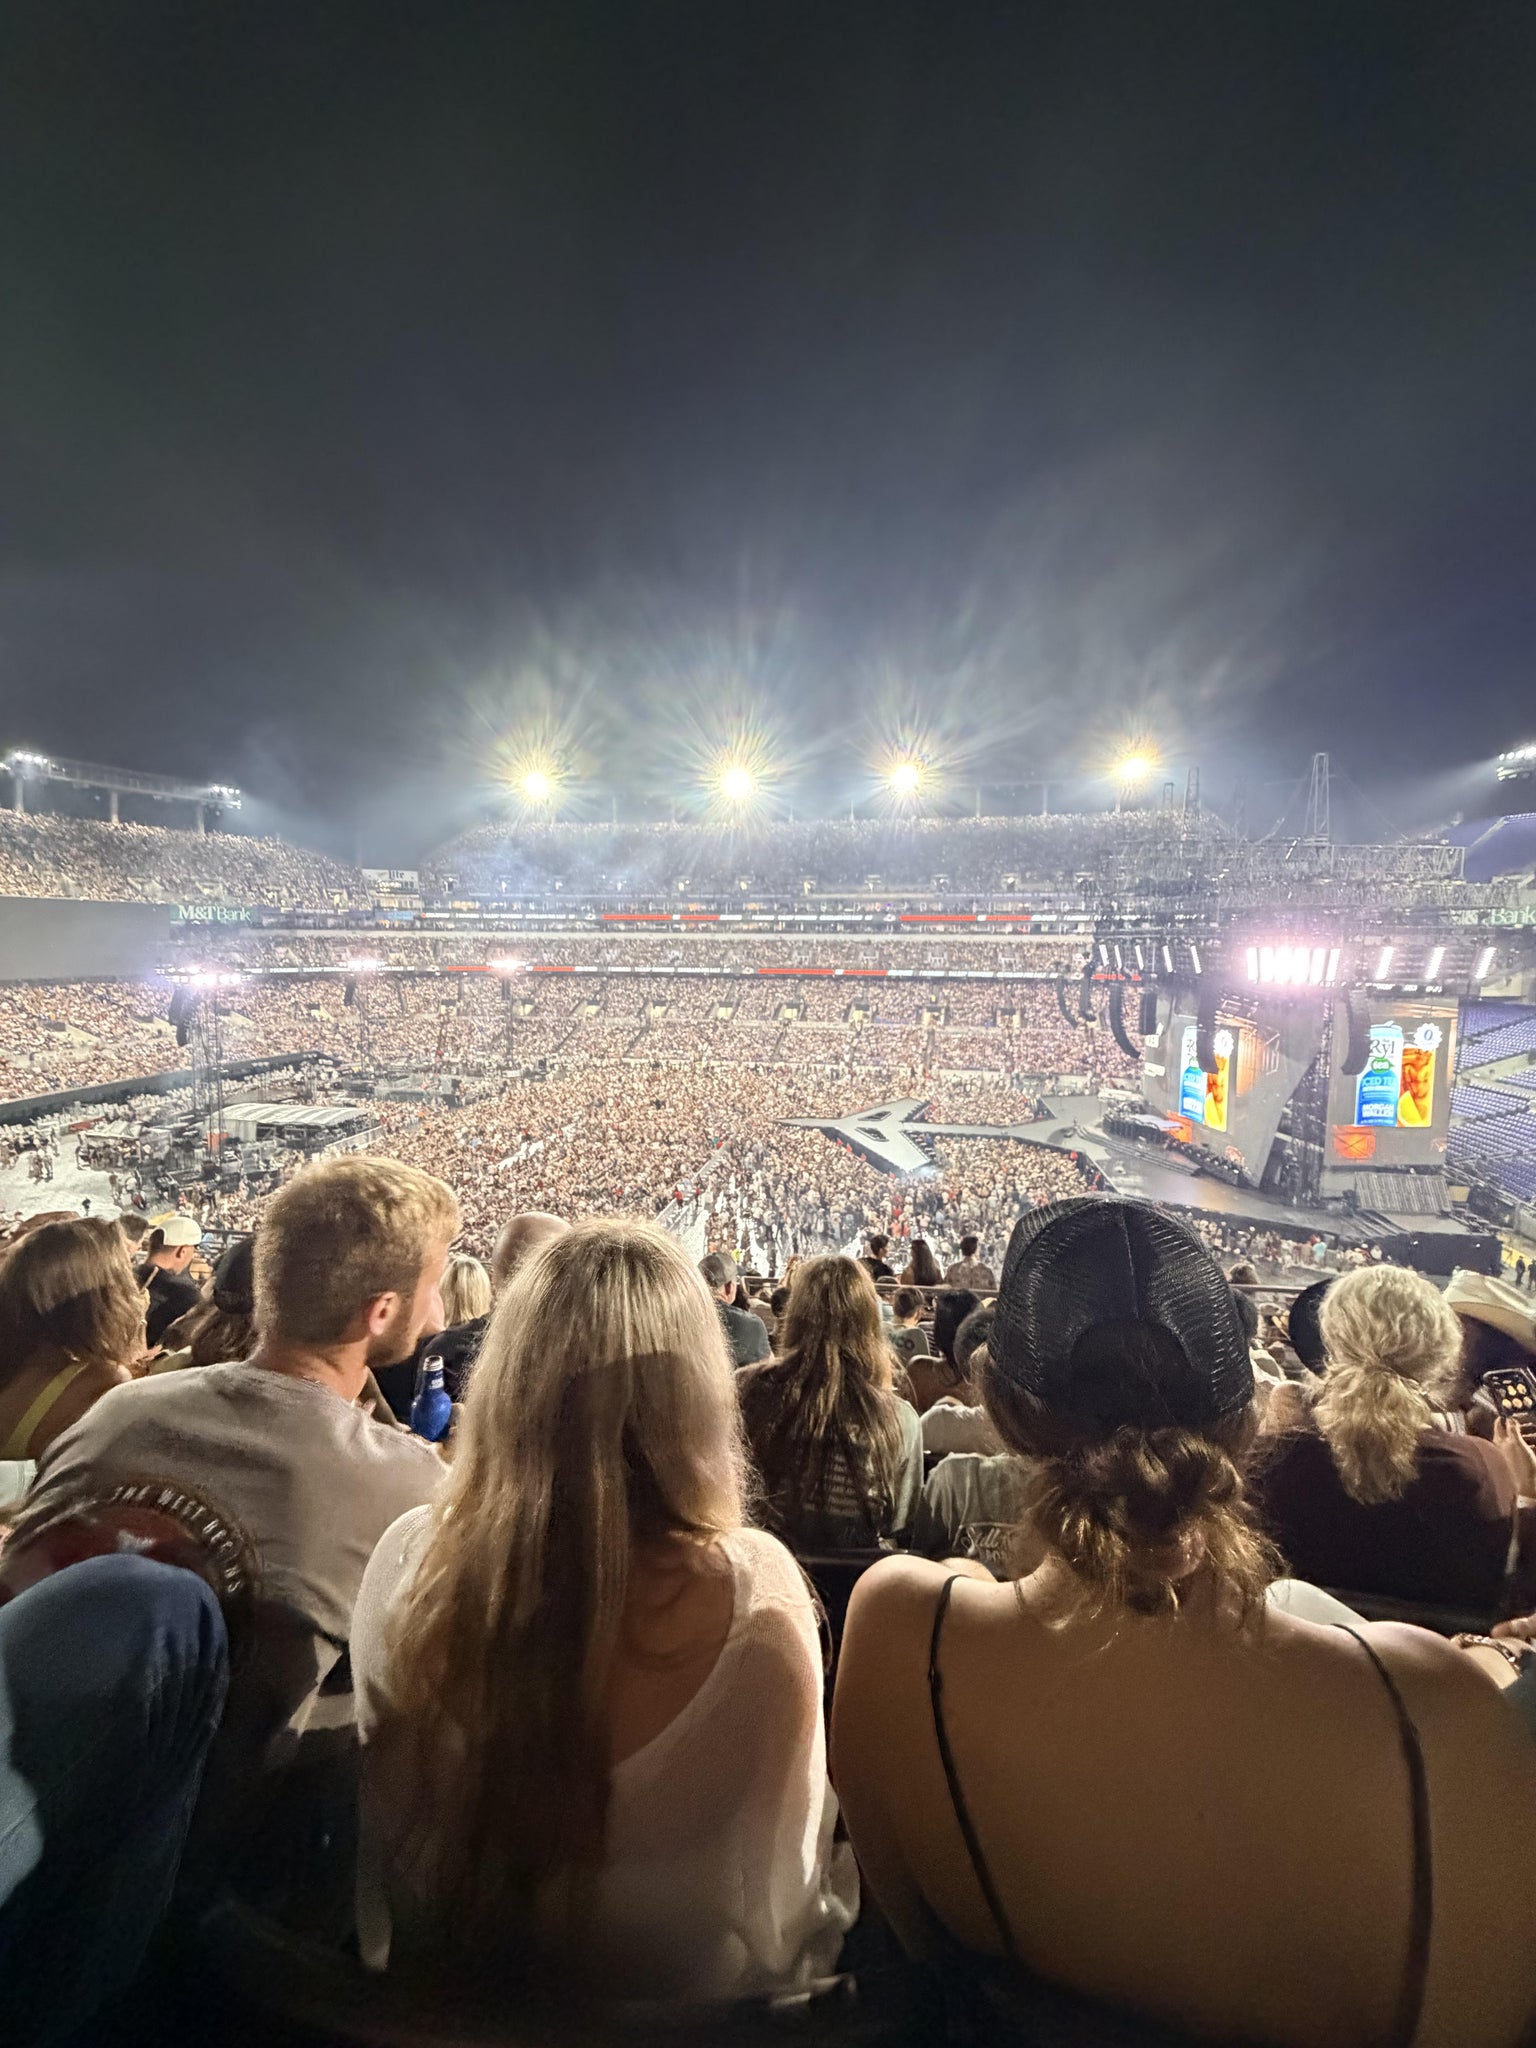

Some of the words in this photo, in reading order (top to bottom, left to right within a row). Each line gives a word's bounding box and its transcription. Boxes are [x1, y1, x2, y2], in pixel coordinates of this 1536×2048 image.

[179, 905, 216, 920] M&T
[217, 906, 252, 922] Bank
[1491, 906, 1536, 925] Bank
[157, 1487, 207, 1521] WEST
